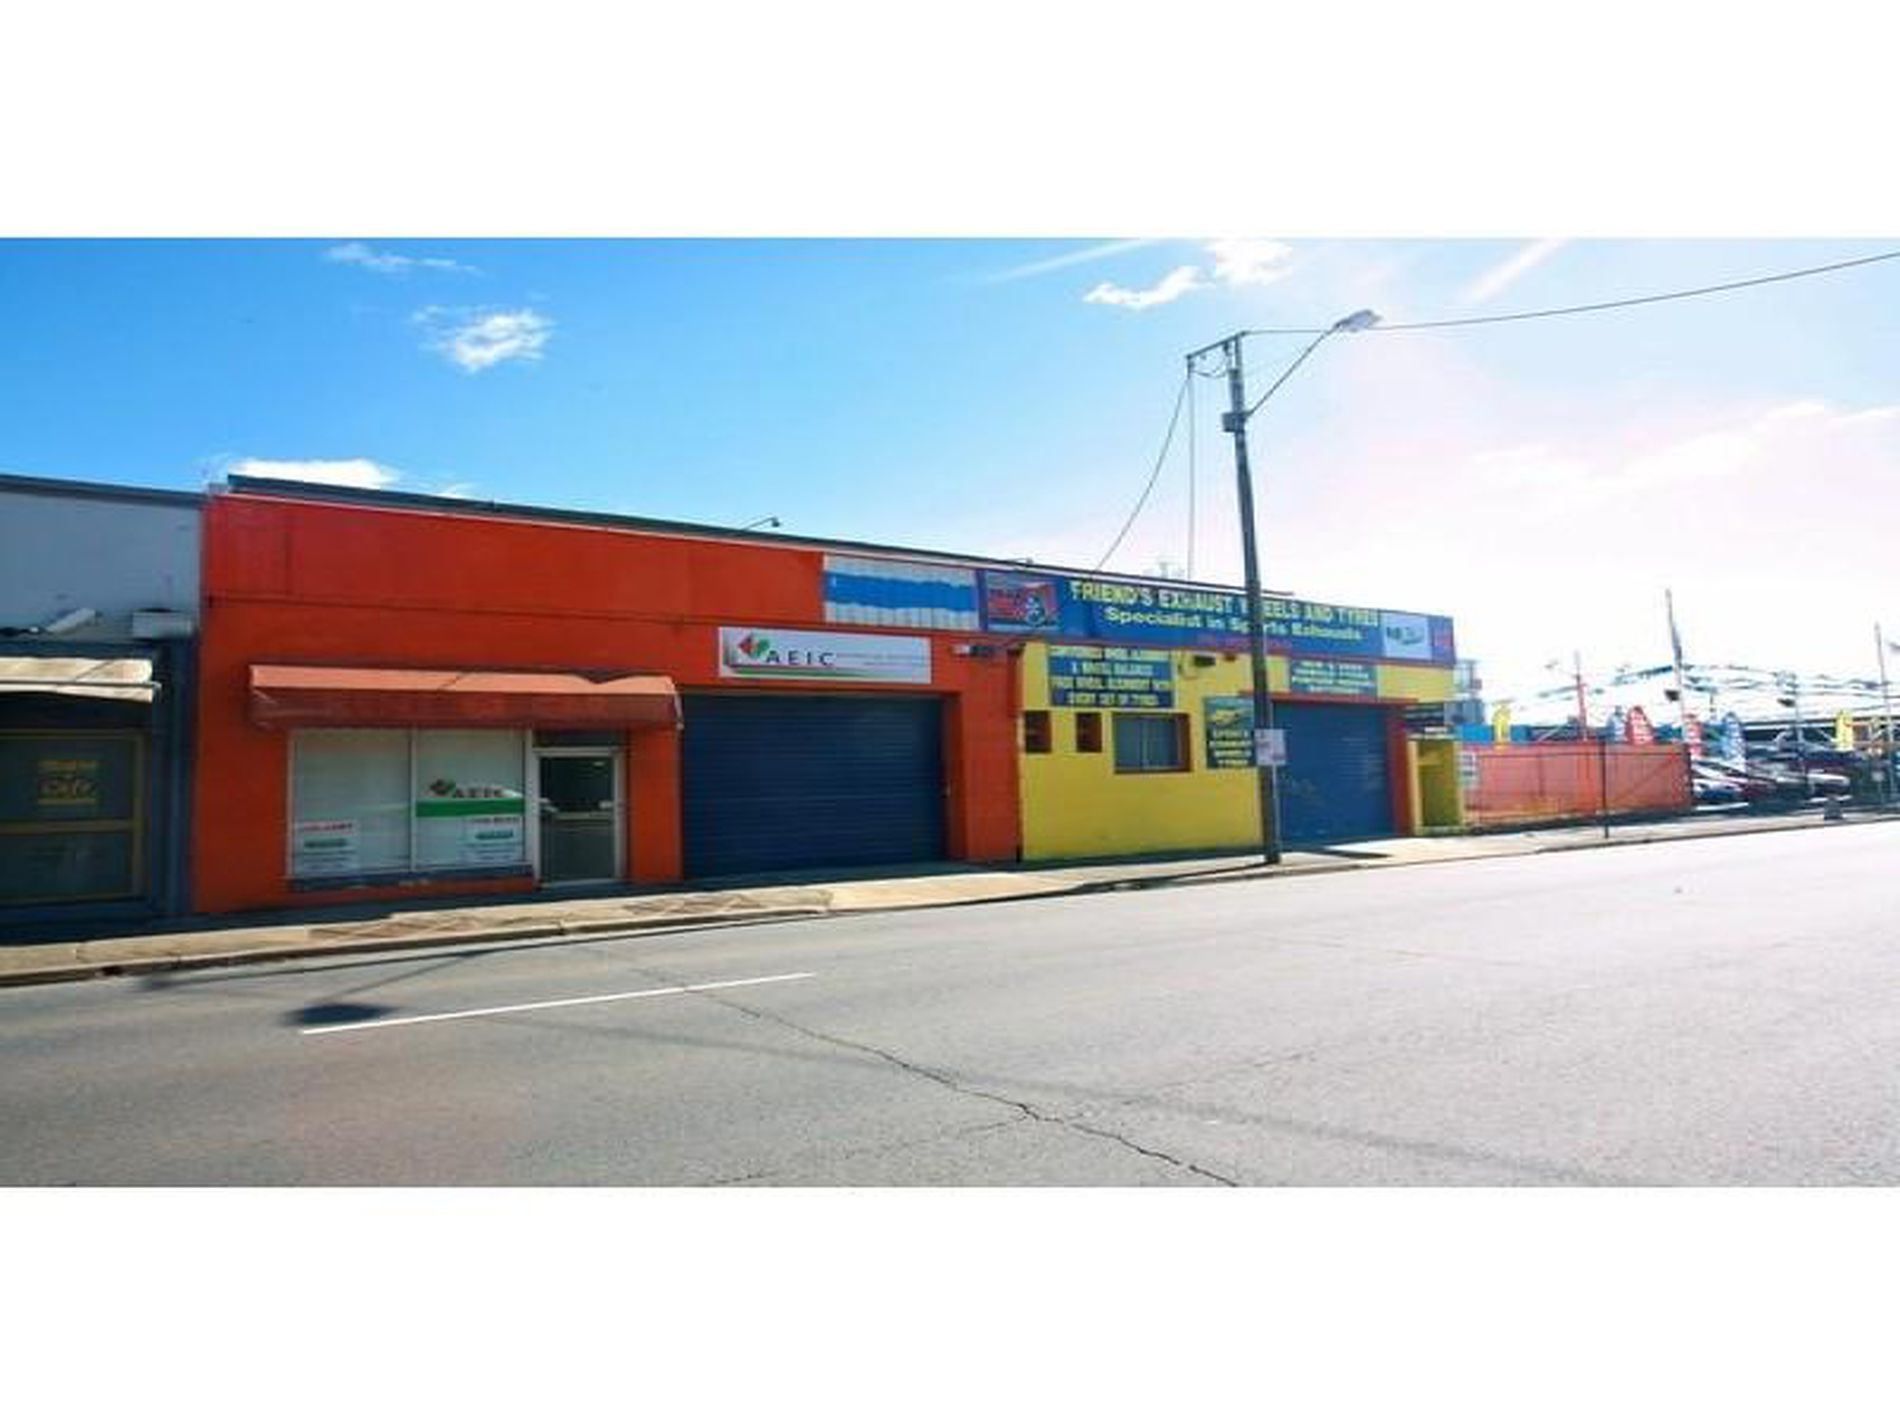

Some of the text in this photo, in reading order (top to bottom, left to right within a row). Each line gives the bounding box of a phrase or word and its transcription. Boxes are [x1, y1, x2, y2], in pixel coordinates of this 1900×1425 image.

[1070, 580, 1154, 606] FRIEND'S
[1158, 588, 1234, 613] EXHAUST
[1304, 603, 1333, 623] AND
[1104, 605, 1203, 629] Specialist
[766, 650, 835, 667] AEIC
